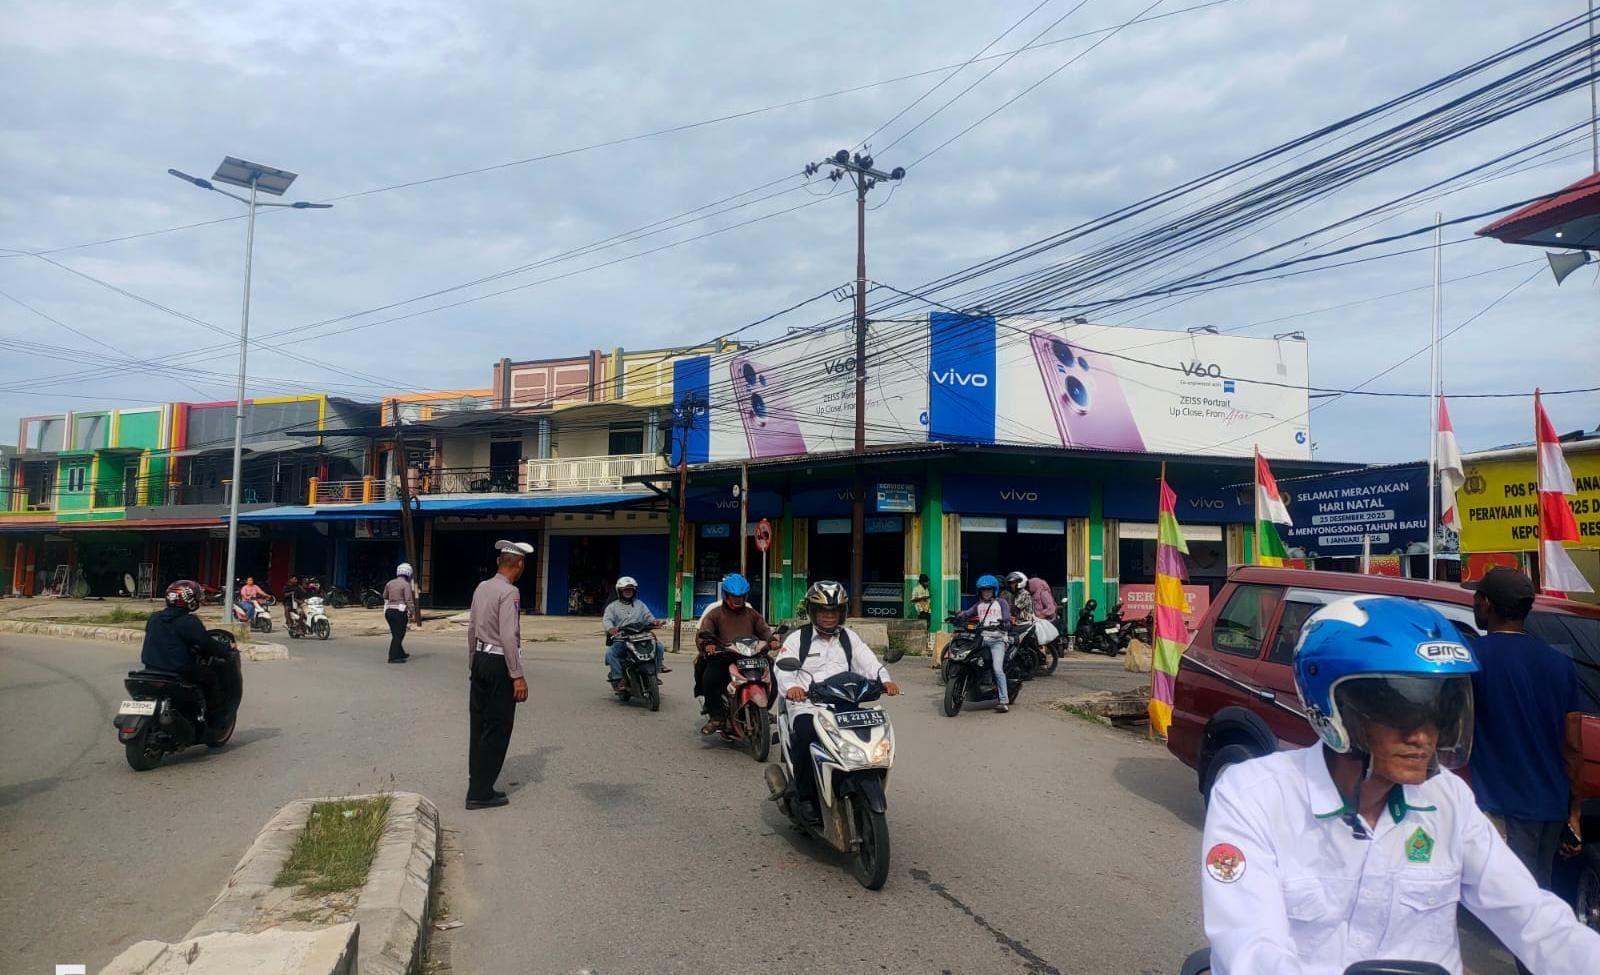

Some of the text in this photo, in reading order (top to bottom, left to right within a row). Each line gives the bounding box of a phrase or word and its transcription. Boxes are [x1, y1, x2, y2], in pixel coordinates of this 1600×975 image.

[823, 357, 856, 374] V60
[1180, 361, 1221, 378] V60
[932, 368, 988, 387] vivo
[841, 390, 857, 400] Portr
[1180, 396, 1231, 408] ZEISS Portrait
[816, 406, 825, 415] Up
[844, 401, 857, 410] Fro
[1169, 407, 1181, 417] Up
[1182, 408, 1205, 418] Close,
[1206, 410, 1226, 419] From
[999, 488, 1039, 501] vivo
[1297, 481, 1409, 502] SELAMAT MERAYAKAN
[1504, 483, 1526, 498] POS
[715, 499, 740, 509] vivo
[1190, 497, 1225, 509] vivo
[1319, 498, 1385, 513] HARI NATAL
[1329, 513, 1366, 523] DESEMBER
[1367, 511, 1387, 520] 2025
[1469, 504, 1522, 521] PERAYAAN
[1295, 525, 1364, 537] MENYONGSONG
[1366, 521, 1398, 532] TAHUN
[1399, 519, 1427, 530] BARU
[1580, 521, 1600, 537] RES
[1329, 536, 1360, 544] JANUARI
[867, 606, 897, 617] oppo
